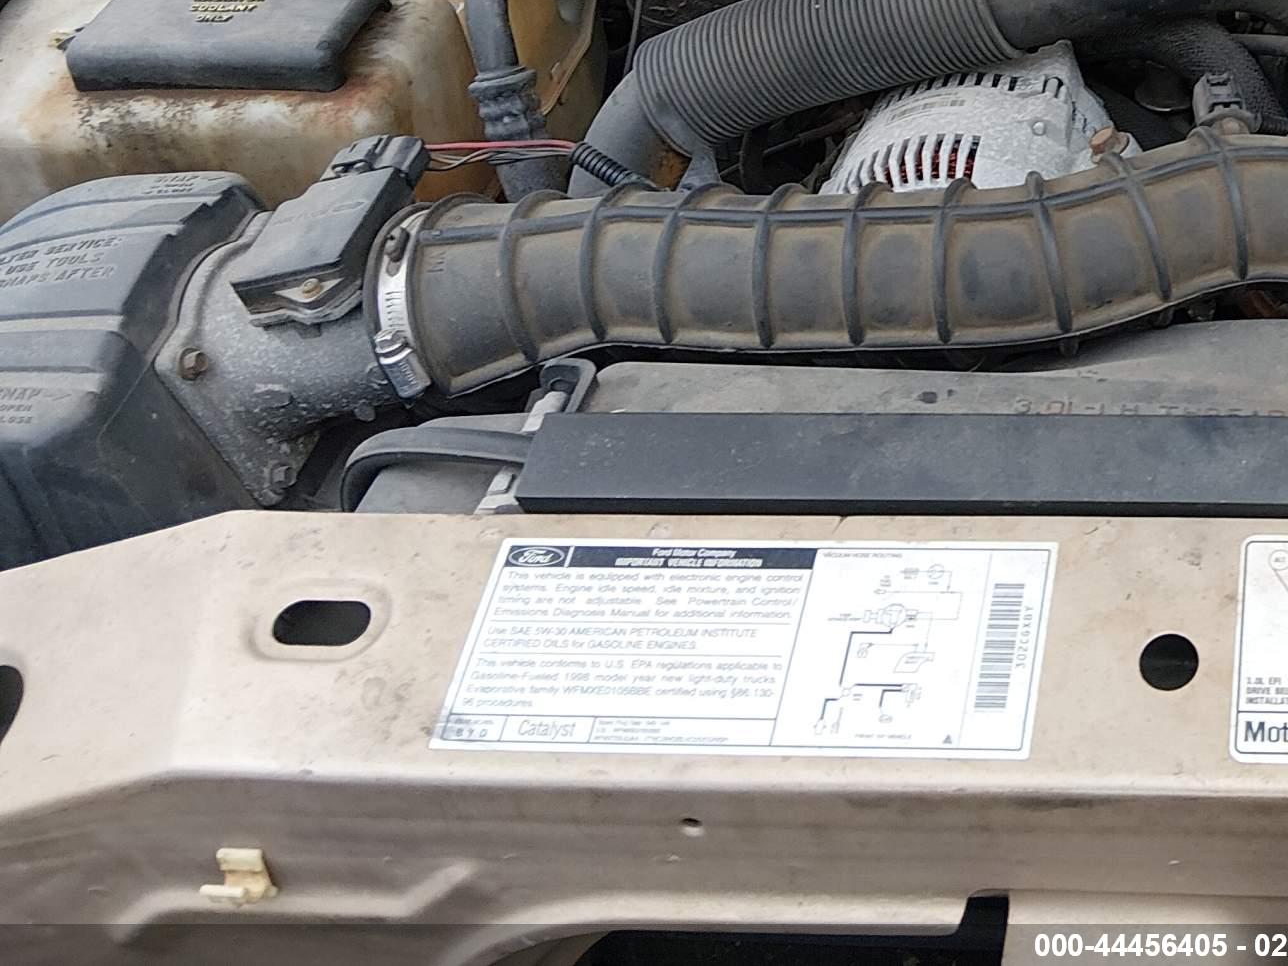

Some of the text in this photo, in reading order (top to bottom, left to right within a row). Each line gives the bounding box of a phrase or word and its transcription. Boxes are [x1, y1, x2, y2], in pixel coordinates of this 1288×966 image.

[189, 4, 258, 12] COOLANT
[195, 14, 234, 22] ONLY
[54, 266, 115, 281] AFTER
[519, 549, 553, 563] Ford
[518, 719, 576, 740] Catalyst
